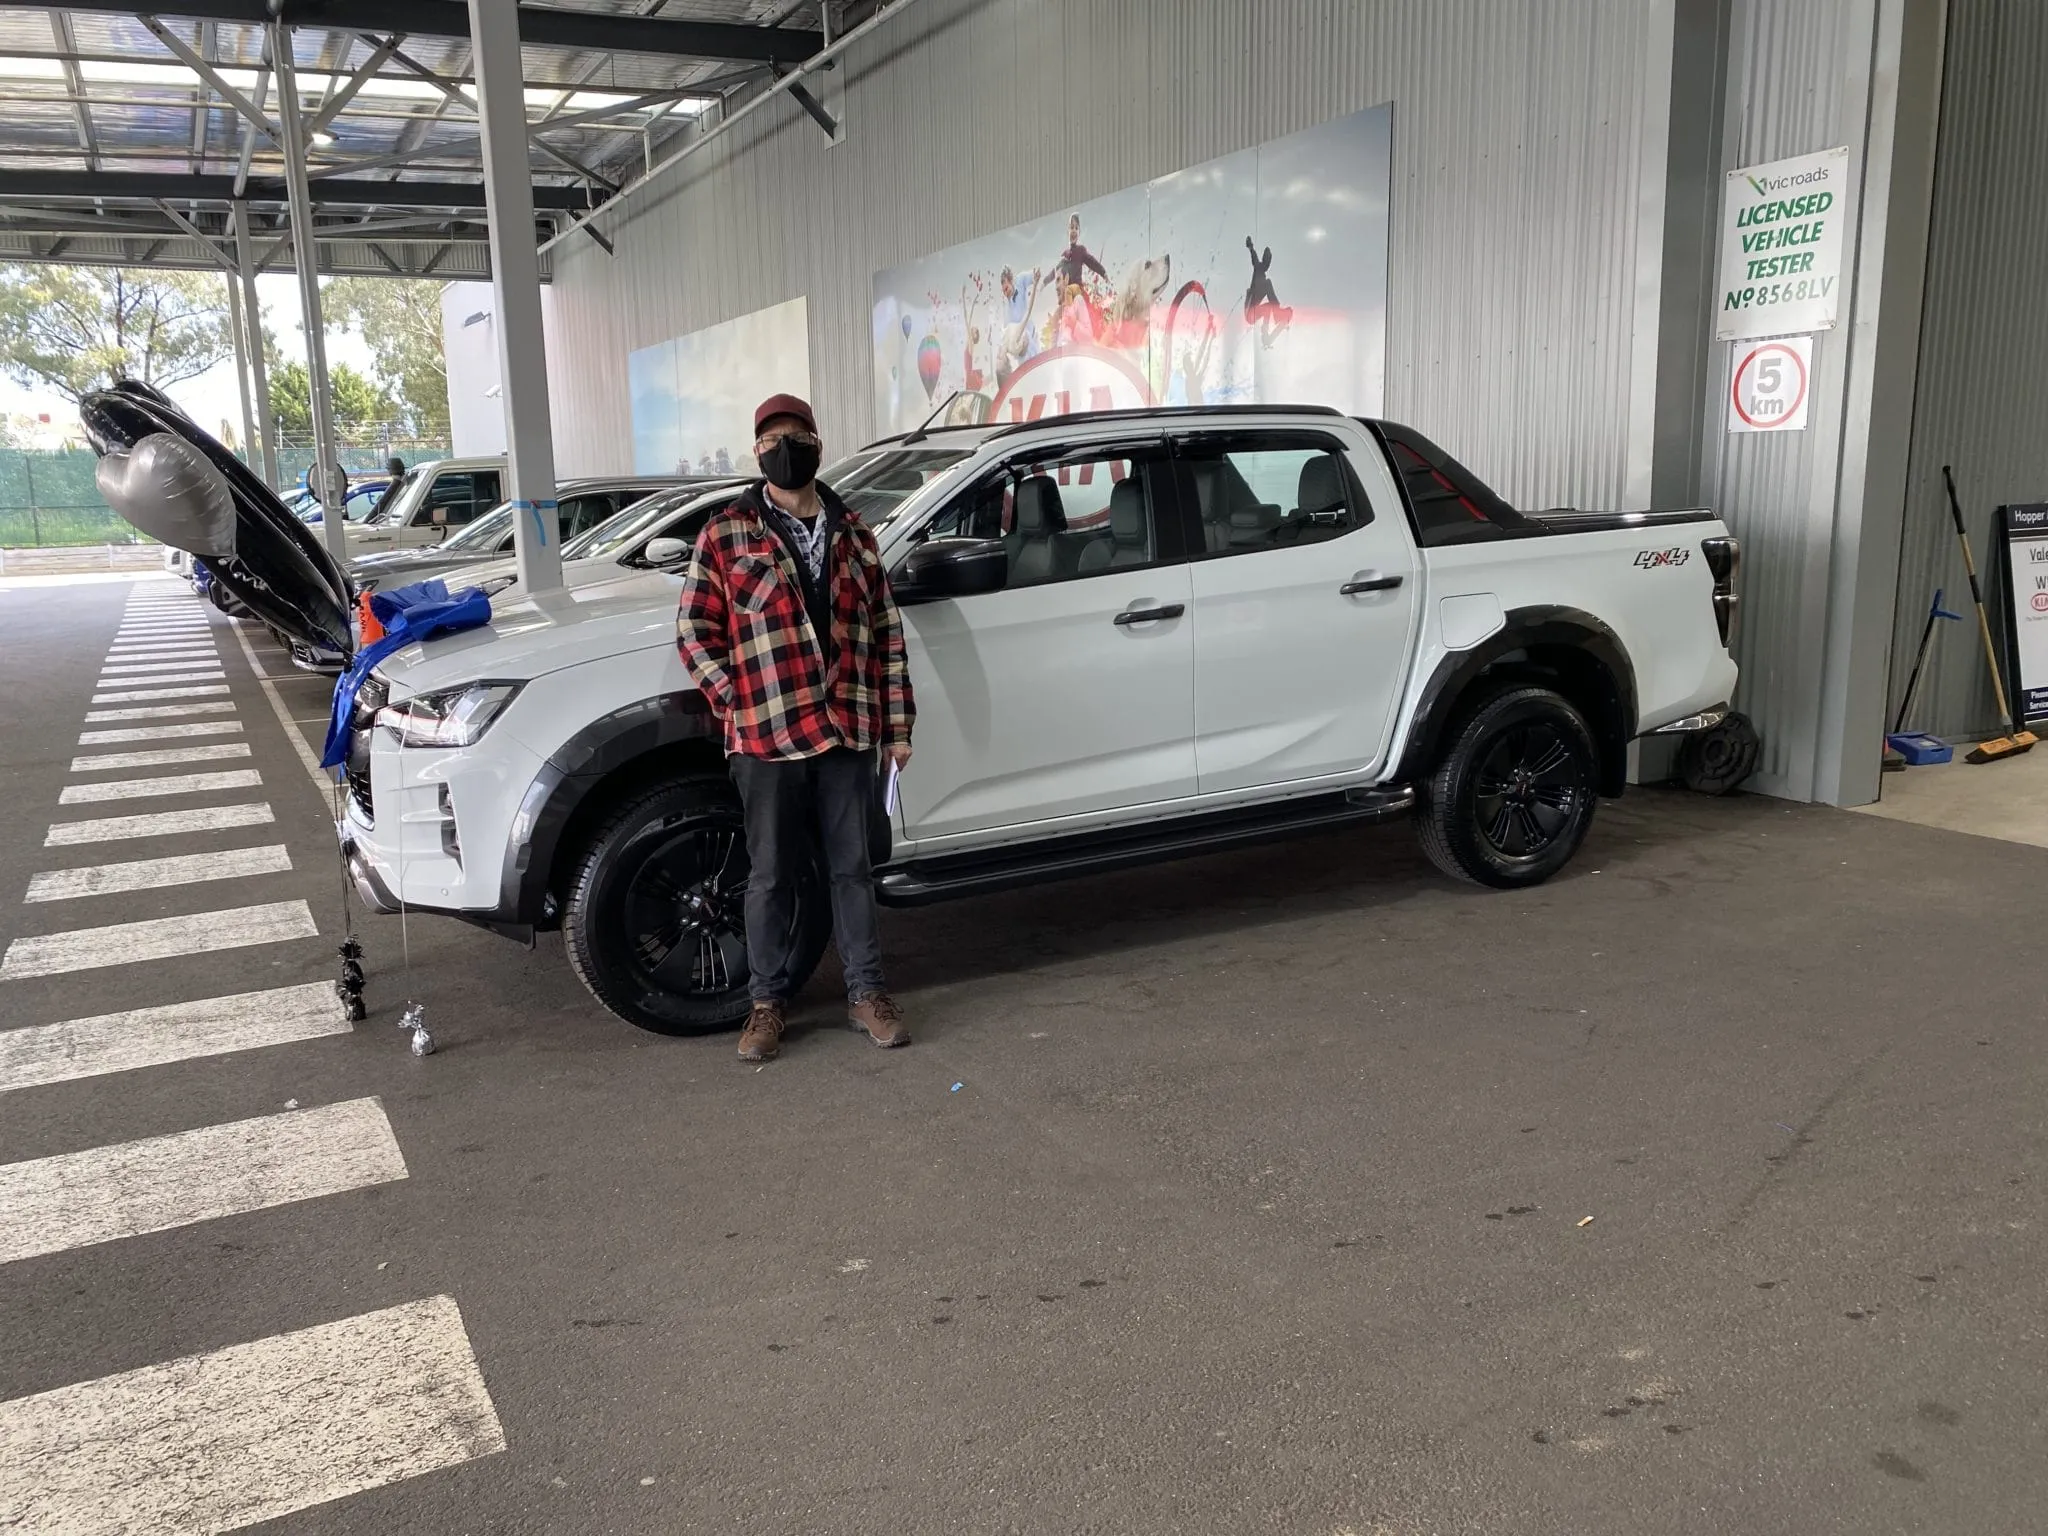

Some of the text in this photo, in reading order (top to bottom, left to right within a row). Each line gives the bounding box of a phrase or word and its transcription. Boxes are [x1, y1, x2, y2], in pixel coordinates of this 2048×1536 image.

[1768, 167, 1829, 191] vic roads
[1736, 191, 1833, 228] LICENSED
[1742, 221, 1825, 253] VEHICLE
[1747, 251, 1815, 280] TESTER
[1757, 357, 1782, 394] 5
[1750, 395, 1784, 416] km
[2014, 510, 2046, 525] Hopper
